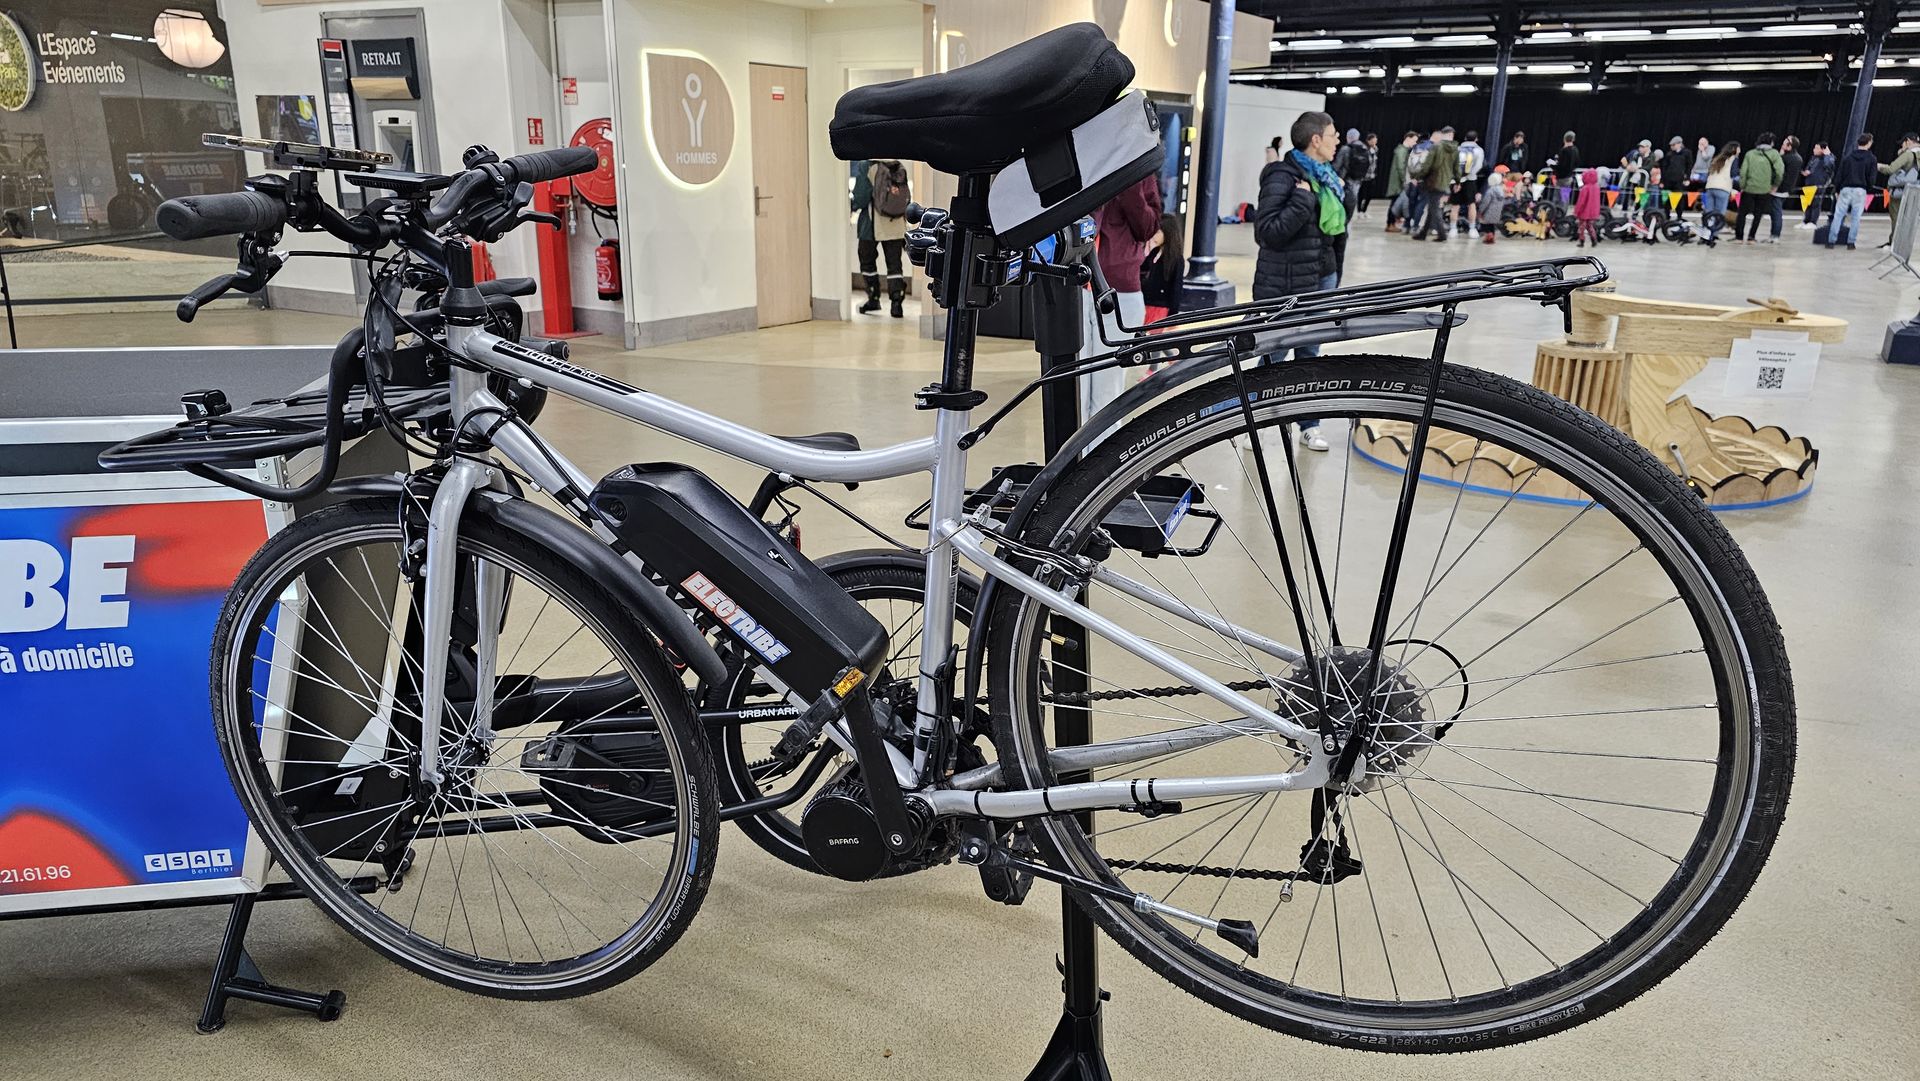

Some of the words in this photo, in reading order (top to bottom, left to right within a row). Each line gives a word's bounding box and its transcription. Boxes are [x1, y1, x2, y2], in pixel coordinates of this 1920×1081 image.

[37, 33, 97, 60] L'Espace
[361, 52, 402, 66] RETRAIT
[42, 60, 126, 84] Evénements
[676, 152, 718, 165] HOMMES
[1262, 379, 1351, 399] MARATHON
[1359, 379, 1406, 391] PLUS
[1119, 412, 1197, 463] SCHWALBE
[0, 535, 136, 634] BE
[681, 571, 792, 665] ELECTRIBE
[0, 646, 18, 674] à
[22, 642, 134, 672] domicile
[738, 708, 776, 719] URBAN
[777, 707, 800, 716] ARR
[688, 774, 701, 837] SCHWALBE
[828, 837, 860, 846] BAFANG
[146, 850, 230, 871] ESAT
[672, 875, 693, 921] MARATHON
[655, 921, 672, 942] PLUS
[1330, 1031, 1388, 1045] 37-622
